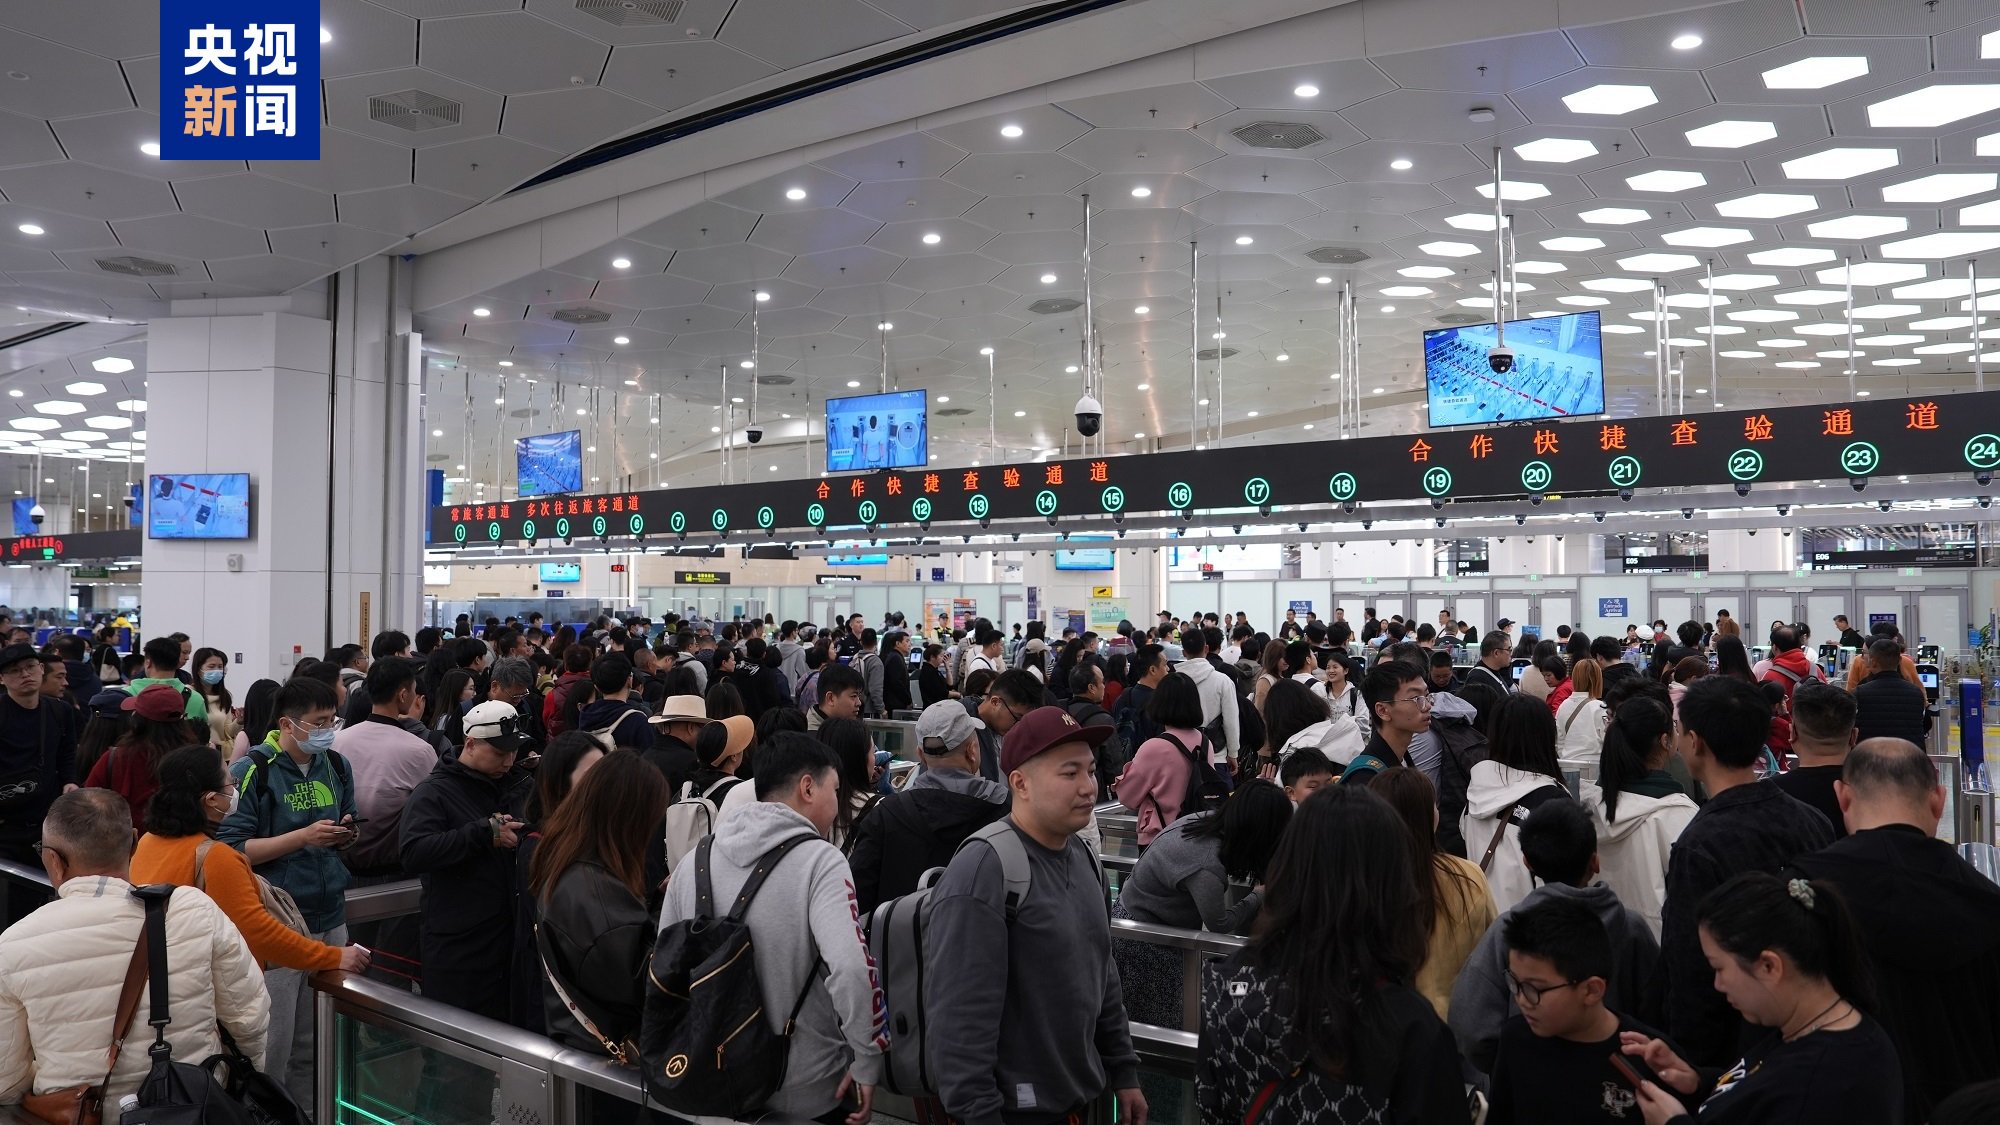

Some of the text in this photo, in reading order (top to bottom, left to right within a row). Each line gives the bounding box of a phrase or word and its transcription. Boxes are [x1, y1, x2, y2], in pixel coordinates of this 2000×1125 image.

[1410, 401, 1939, 462] 合作快捷查验通道
[1971, 442, 1998, 459] 24
[1733, 456, 1756, 472] 22
[1847, 450, 1871, 466] 23
[1526, 468, 1546, 483] 20
[1614, 463, 1631, 478] 21
[816, 461, 1109, 499] 合作快捷查验通道
[1334, 479, 1351, 493] 18
[1428, 474, 1446, 488] 19
[1173, 488, 1188, 501] 16
[1249, 484, 1265, 497] 17
[1106, 492, 1120, 505] 15
[450, 495, 639, 521] 常旅客通道 多次往返旅客通道
[1625, 557, 1639, 565] E05
[1815, 553, 1830, 561] E06
[1458, 561, 1470, 569] E04
[1061, 713, 1076, 726] NY
[294, 781, 313, 793] THE
[283, 790, 315, 803] NORTH
[291, 798, 318, 812] FACE
